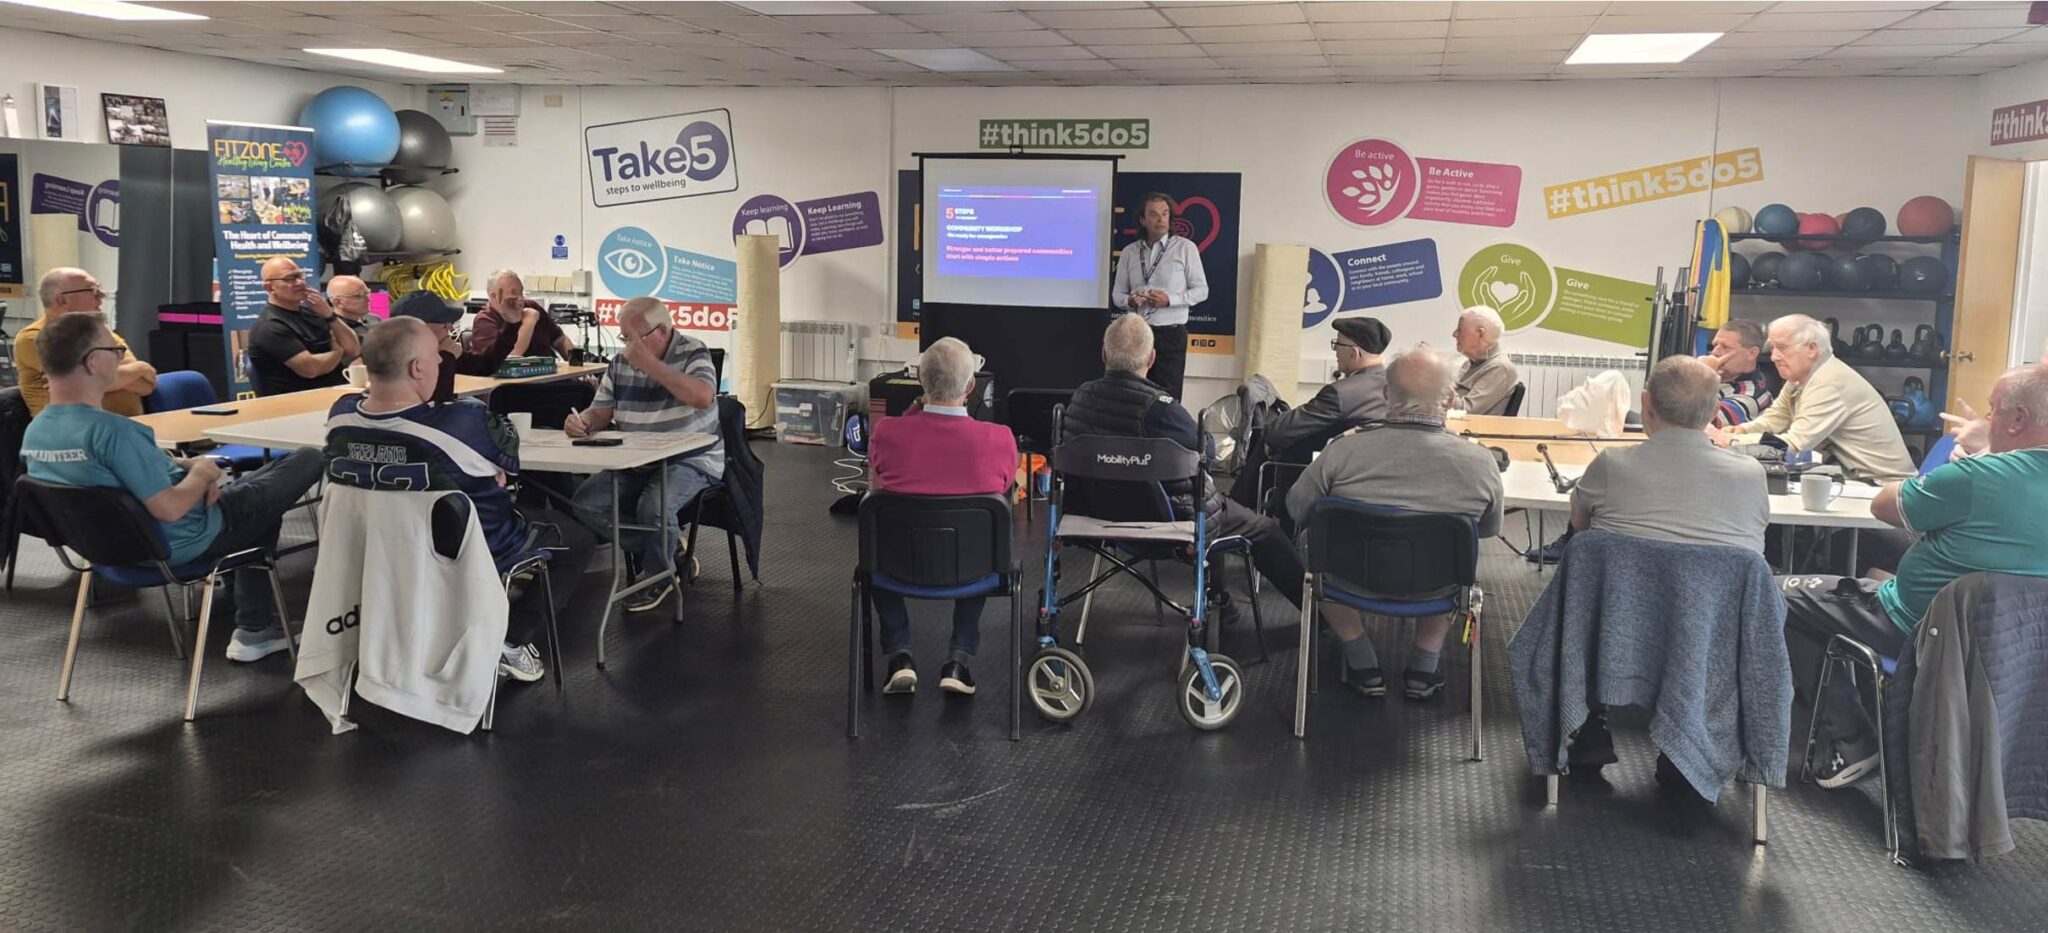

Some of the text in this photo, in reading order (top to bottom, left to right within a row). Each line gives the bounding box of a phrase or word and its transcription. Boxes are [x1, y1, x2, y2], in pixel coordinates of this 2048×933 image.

[1993, 105, 2048, 140] #think
[982, 123, 1147, 145] #think5do5
[214, 139, 284, 161] FITZONE
[1355, 149, 1394, 160] Be active
[1429, 166, 1474, 178] Be Active
[606, 179, 686, 195] steps to wellbeing
[1549, 153, 1760, 214] #think5do5
[742, 204, 788, 216] Keep learning
[807, 201, 862, 215] Keep Learning
[946, 208, 954, 219] 5
[222, 230, 312, 241] The Heart of Community
[230, 241, 309, 251] Health and Wellbeing
[673, 256, 716, 271] Take Notice
[1348, 253, 1386, 266] Connect
[1501, 254, 1521, 266] Give
[1566, 278, 1590, 290] Give
[348, 443, 406, 464] IRELAND
[1097, 454, 1150, 466] MobilityPlus
